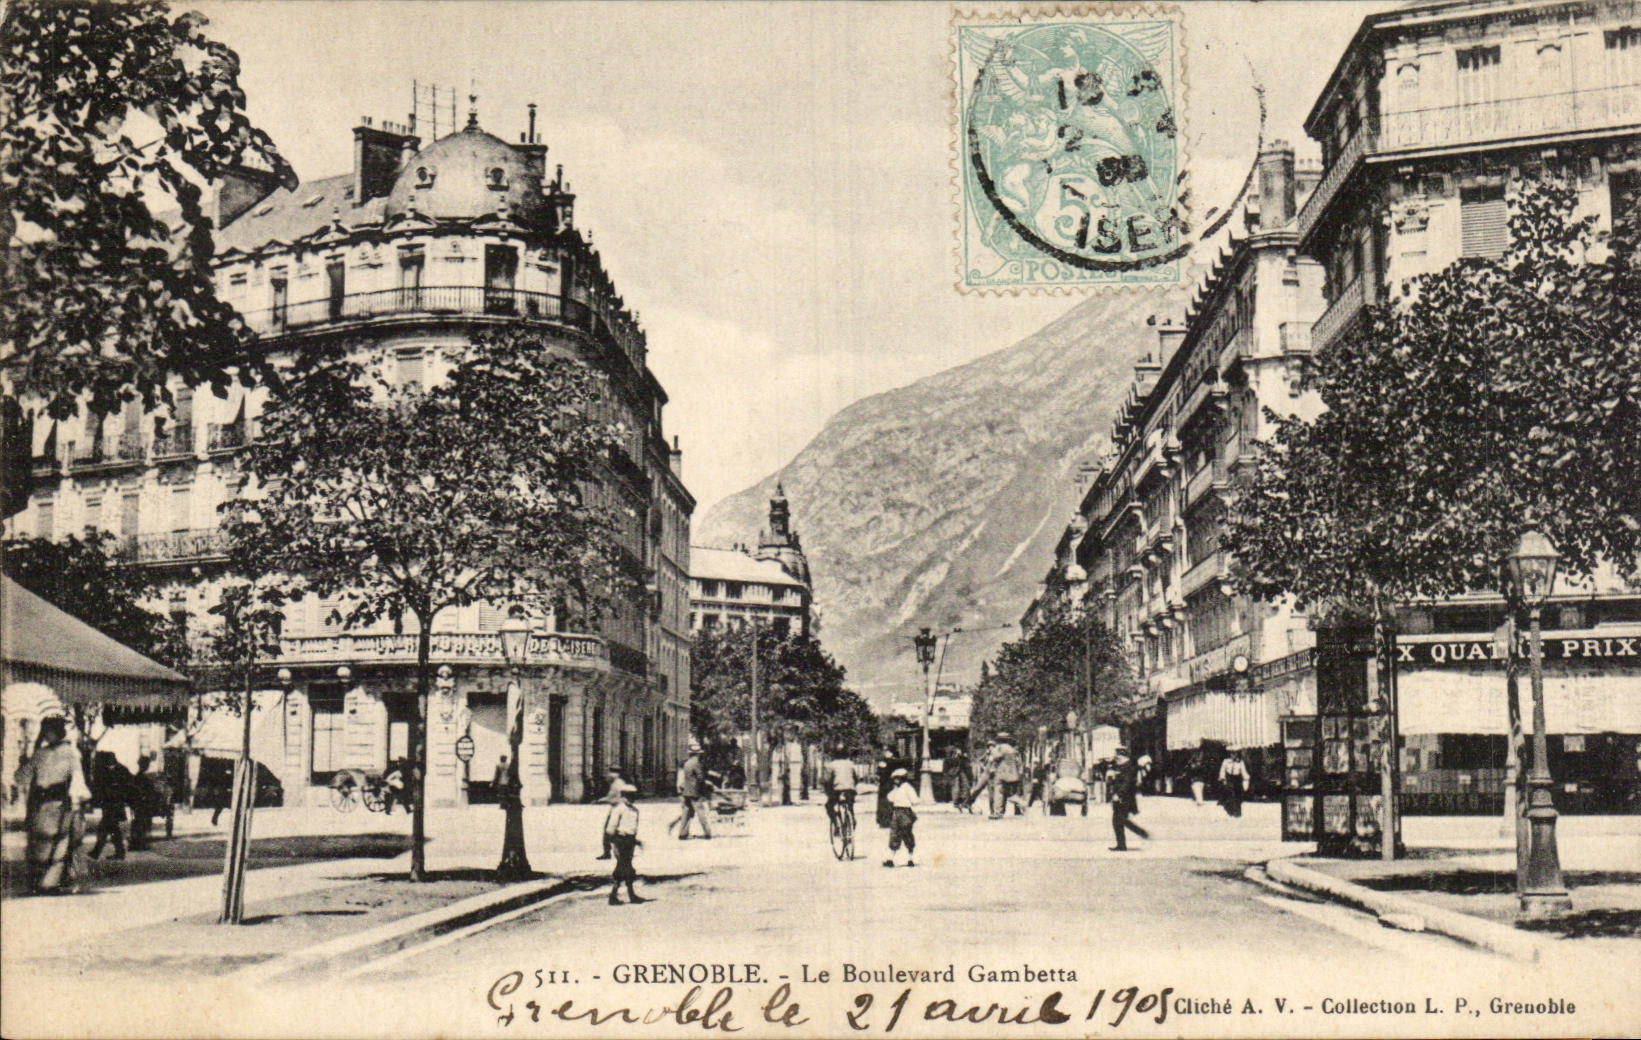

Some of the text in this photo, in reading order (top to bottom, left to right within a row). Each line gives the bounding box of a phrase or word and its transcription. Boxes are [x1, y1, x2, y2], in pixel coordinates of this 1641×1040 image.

[1562, 637, 1638, 658] PRIX
[487, 970, 1174, 1032] Grenoble le 21 avril 1905
